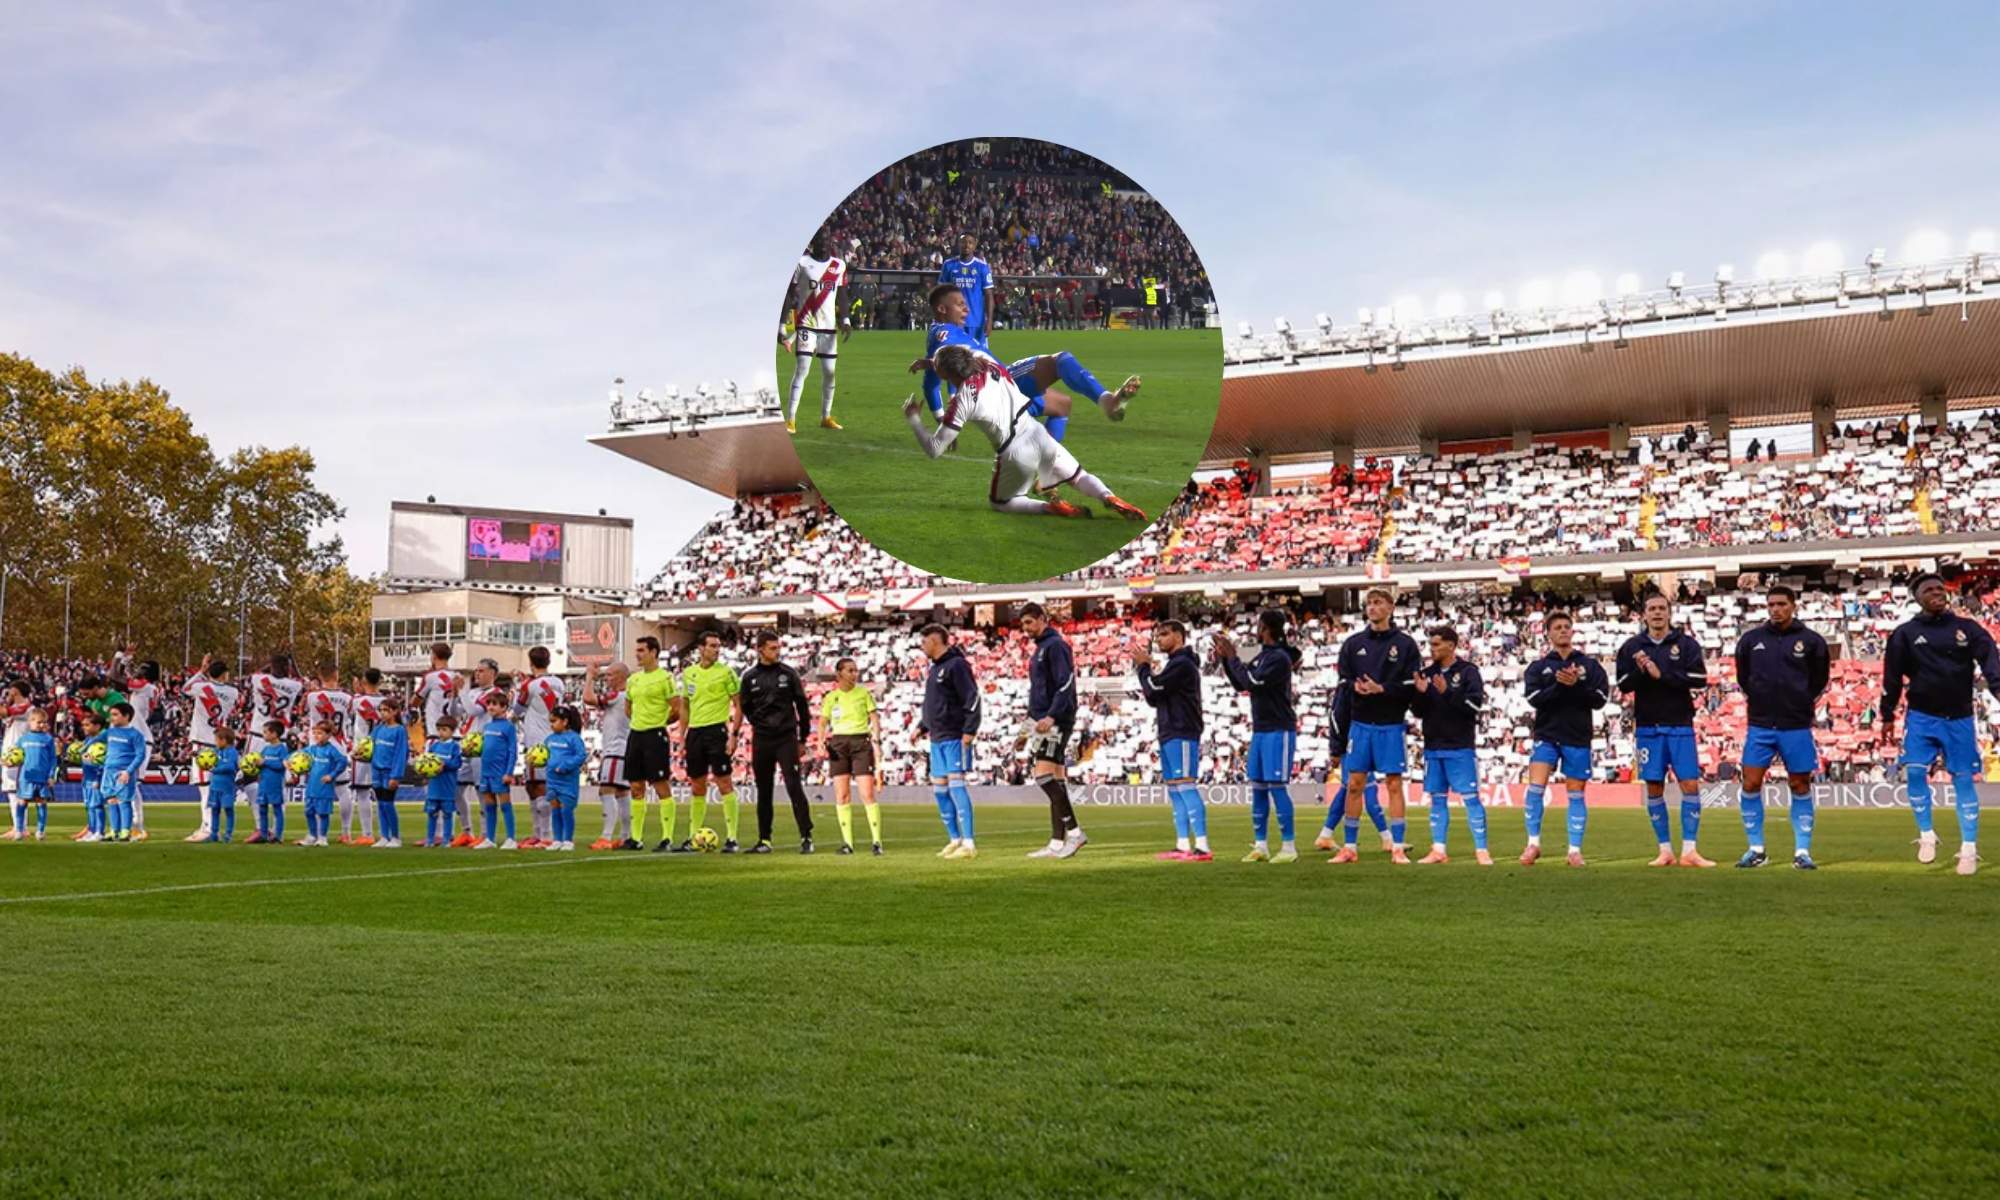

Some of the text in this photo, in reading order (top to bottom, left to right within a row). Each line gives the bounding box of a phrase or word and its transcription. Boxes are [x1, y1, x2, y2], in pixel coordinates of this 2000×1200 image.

[809, 280, 835, 291] DIGI
[384, 644, 416, 658] Willy!
[258, 688, 289, 718] 32
